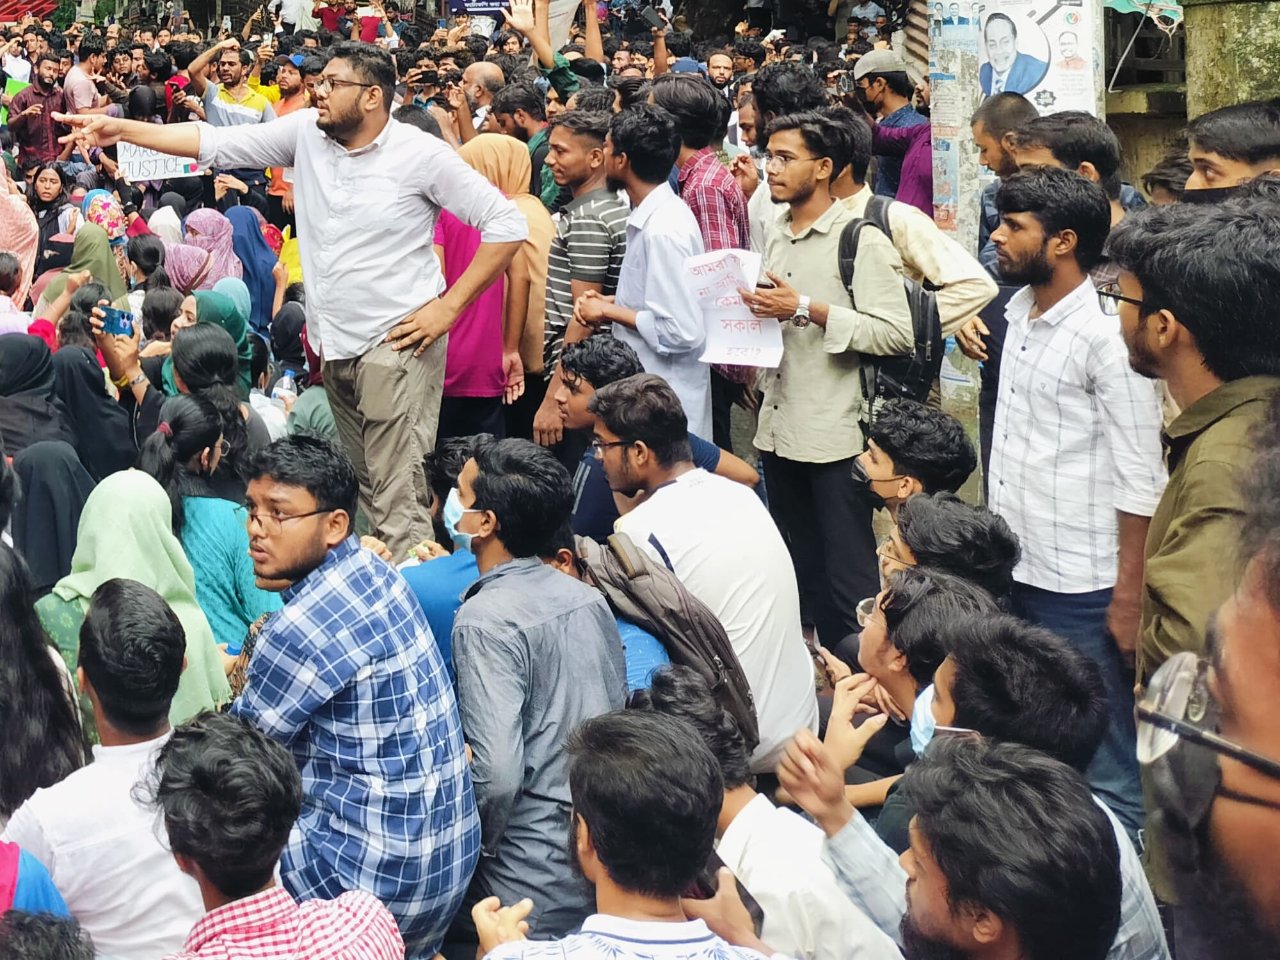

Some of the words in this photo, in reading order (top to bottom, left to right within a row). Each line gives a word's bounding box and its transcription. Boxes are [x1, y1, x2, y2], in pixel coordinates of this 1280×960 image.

[120, 158, 182, 177] JUSTICE
[689, 258, 728, 276] আমরা
[720, 320, 763, 334] সকাল
